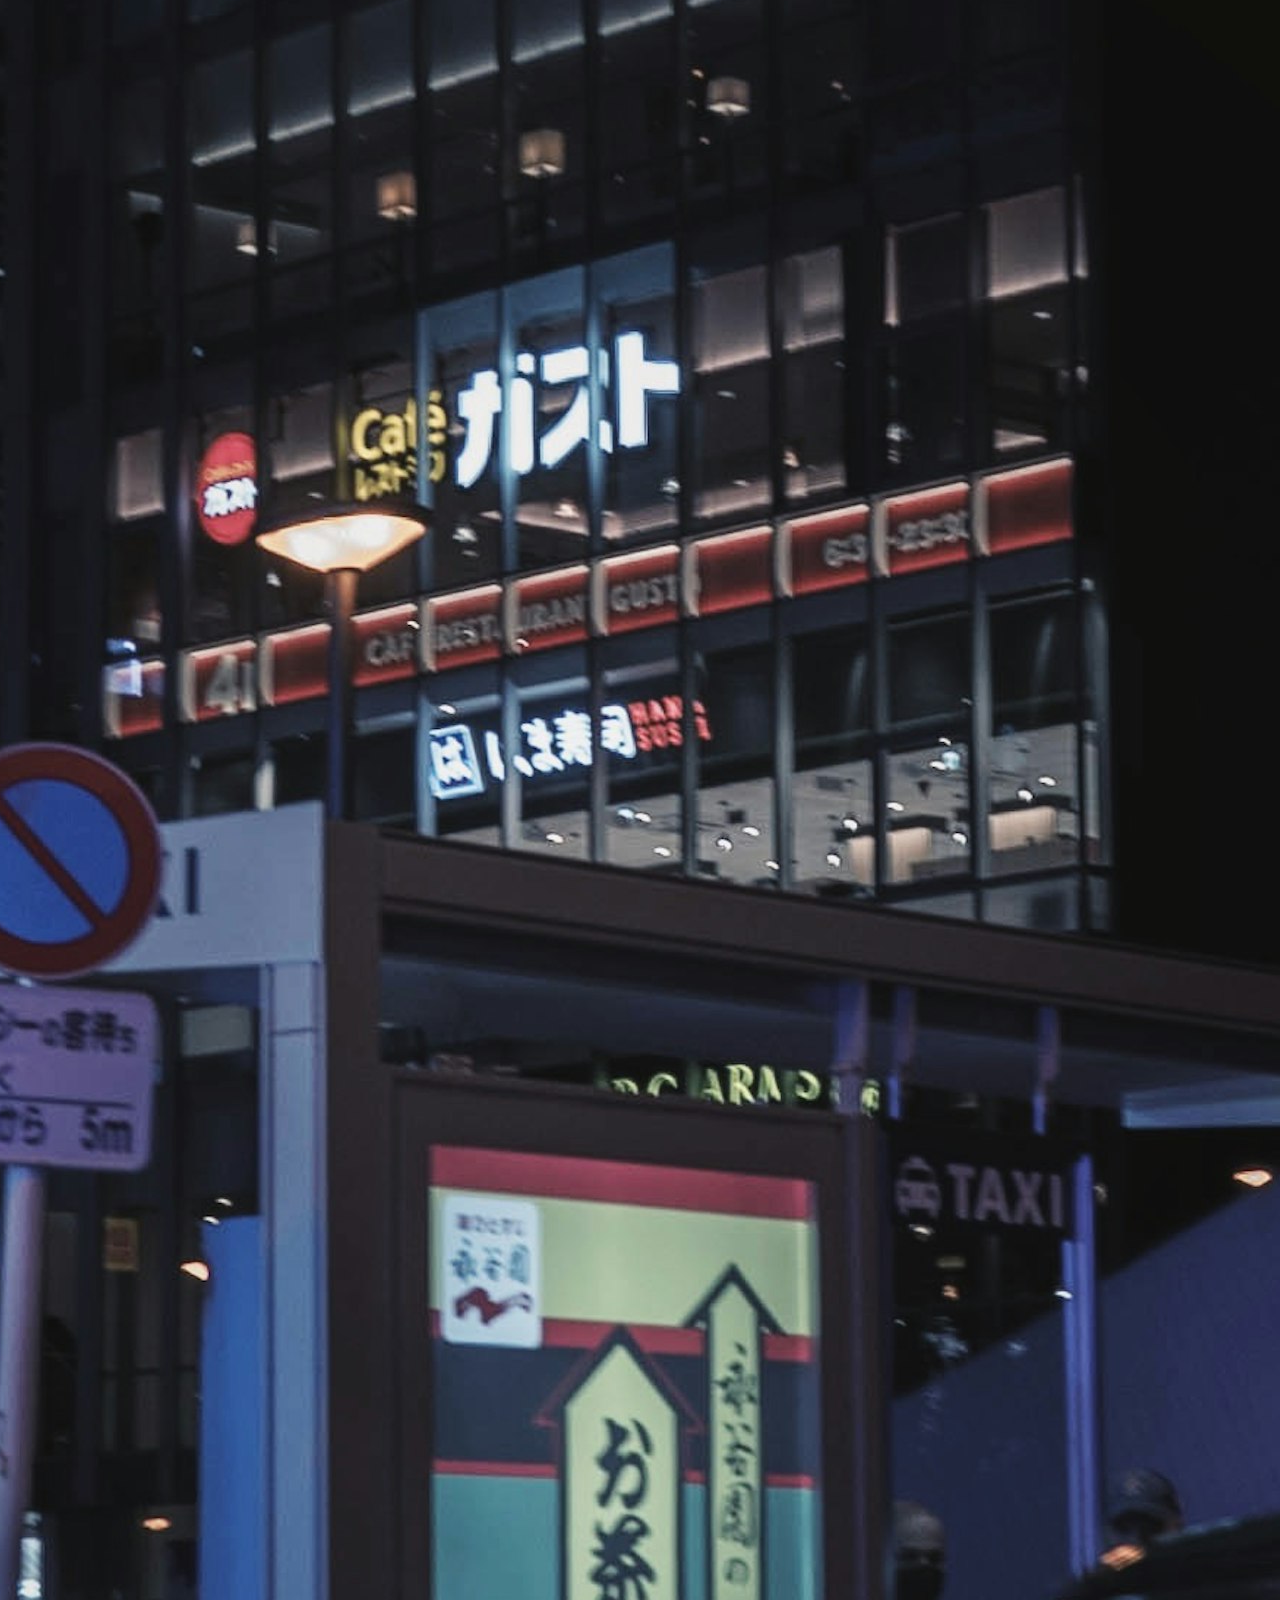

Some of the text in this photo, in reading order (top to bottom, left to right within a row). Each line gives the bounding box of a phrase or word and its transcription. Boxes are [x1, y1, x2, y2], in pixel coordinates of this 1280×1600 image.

[456, 330, 680, 488] ガスト
[364, 626, 417, 667] CAF
[610, 573, 700, 614] GUST
[945, 1162, 1065, 1228] TAXI
